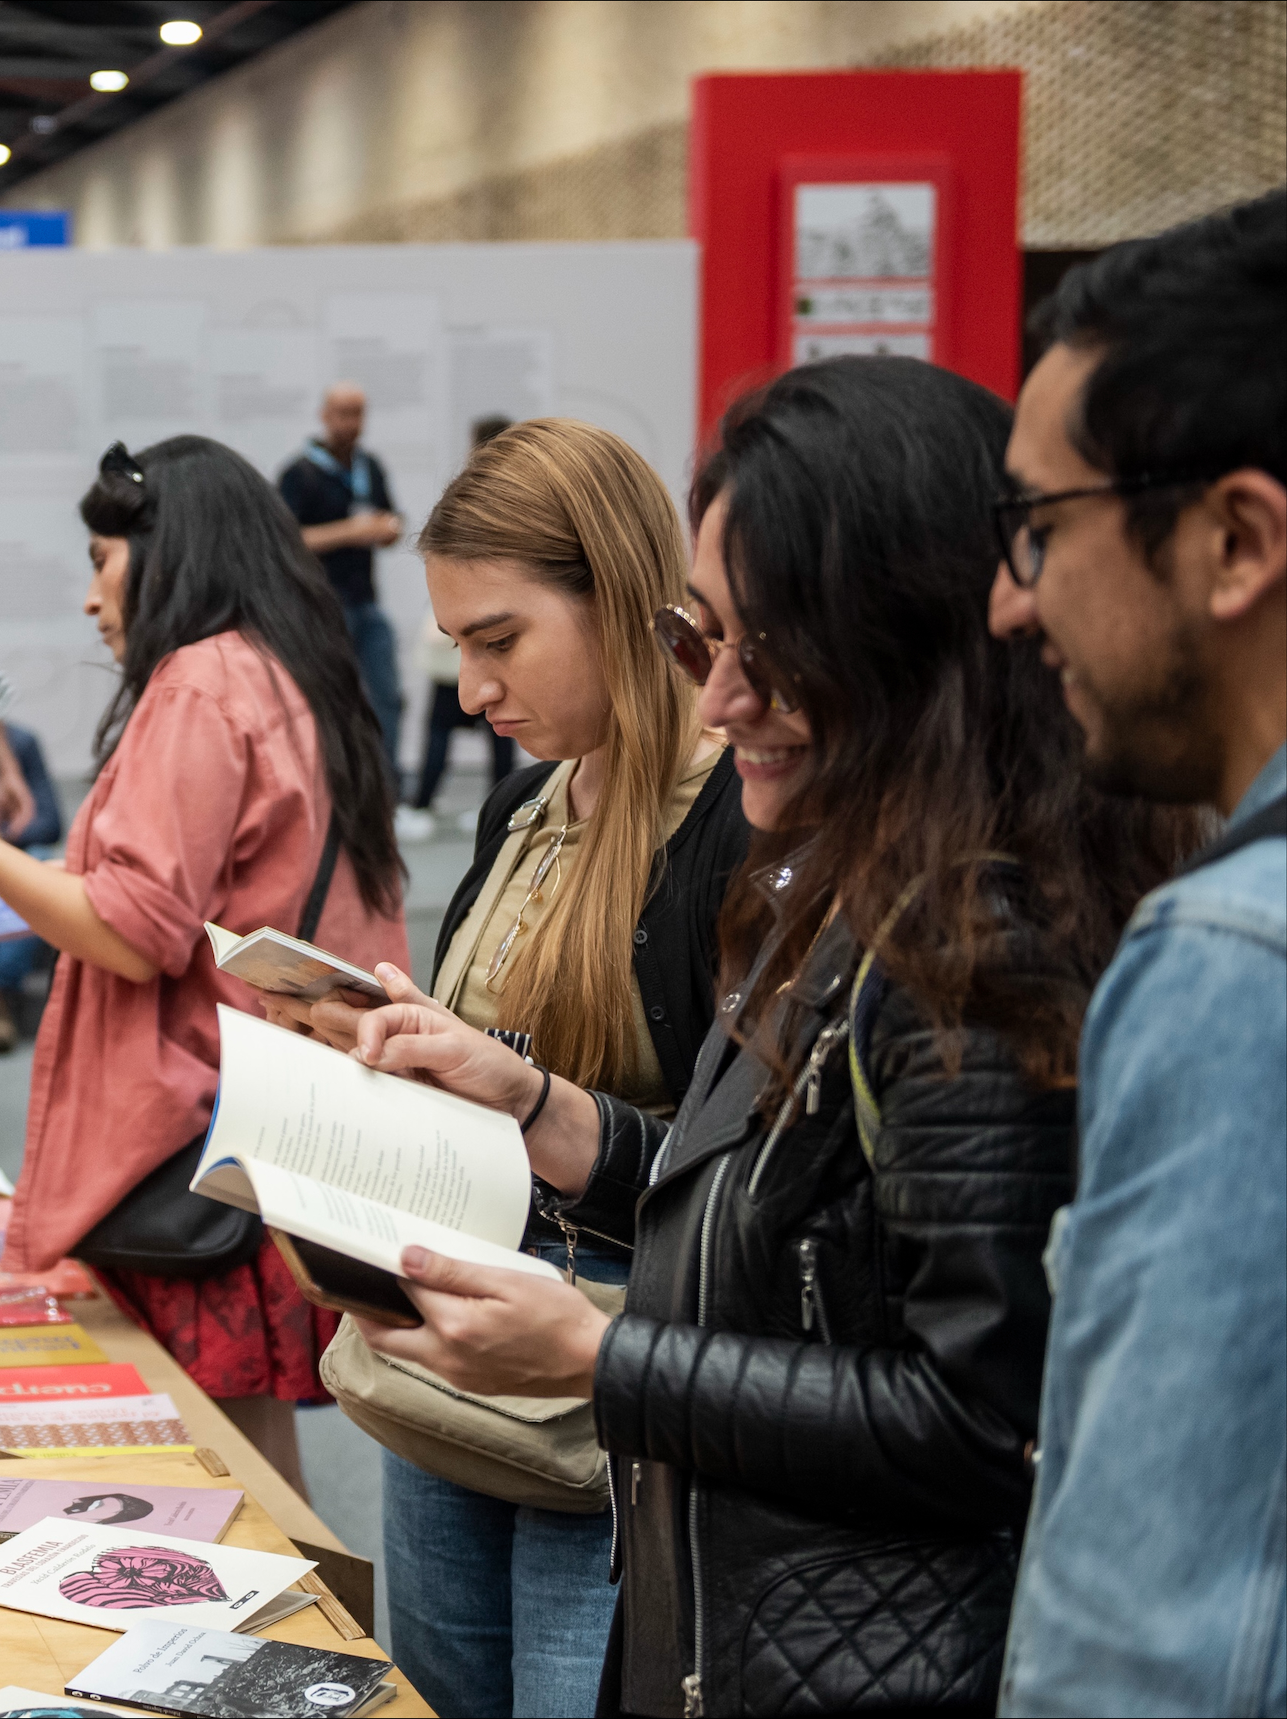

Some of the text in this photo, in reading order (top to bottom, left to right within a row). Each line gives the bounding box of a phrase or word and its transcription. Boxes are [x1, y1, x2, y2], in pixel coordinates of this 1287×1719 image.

[133, 1628, 188, 1674] Polvo de Imperios
